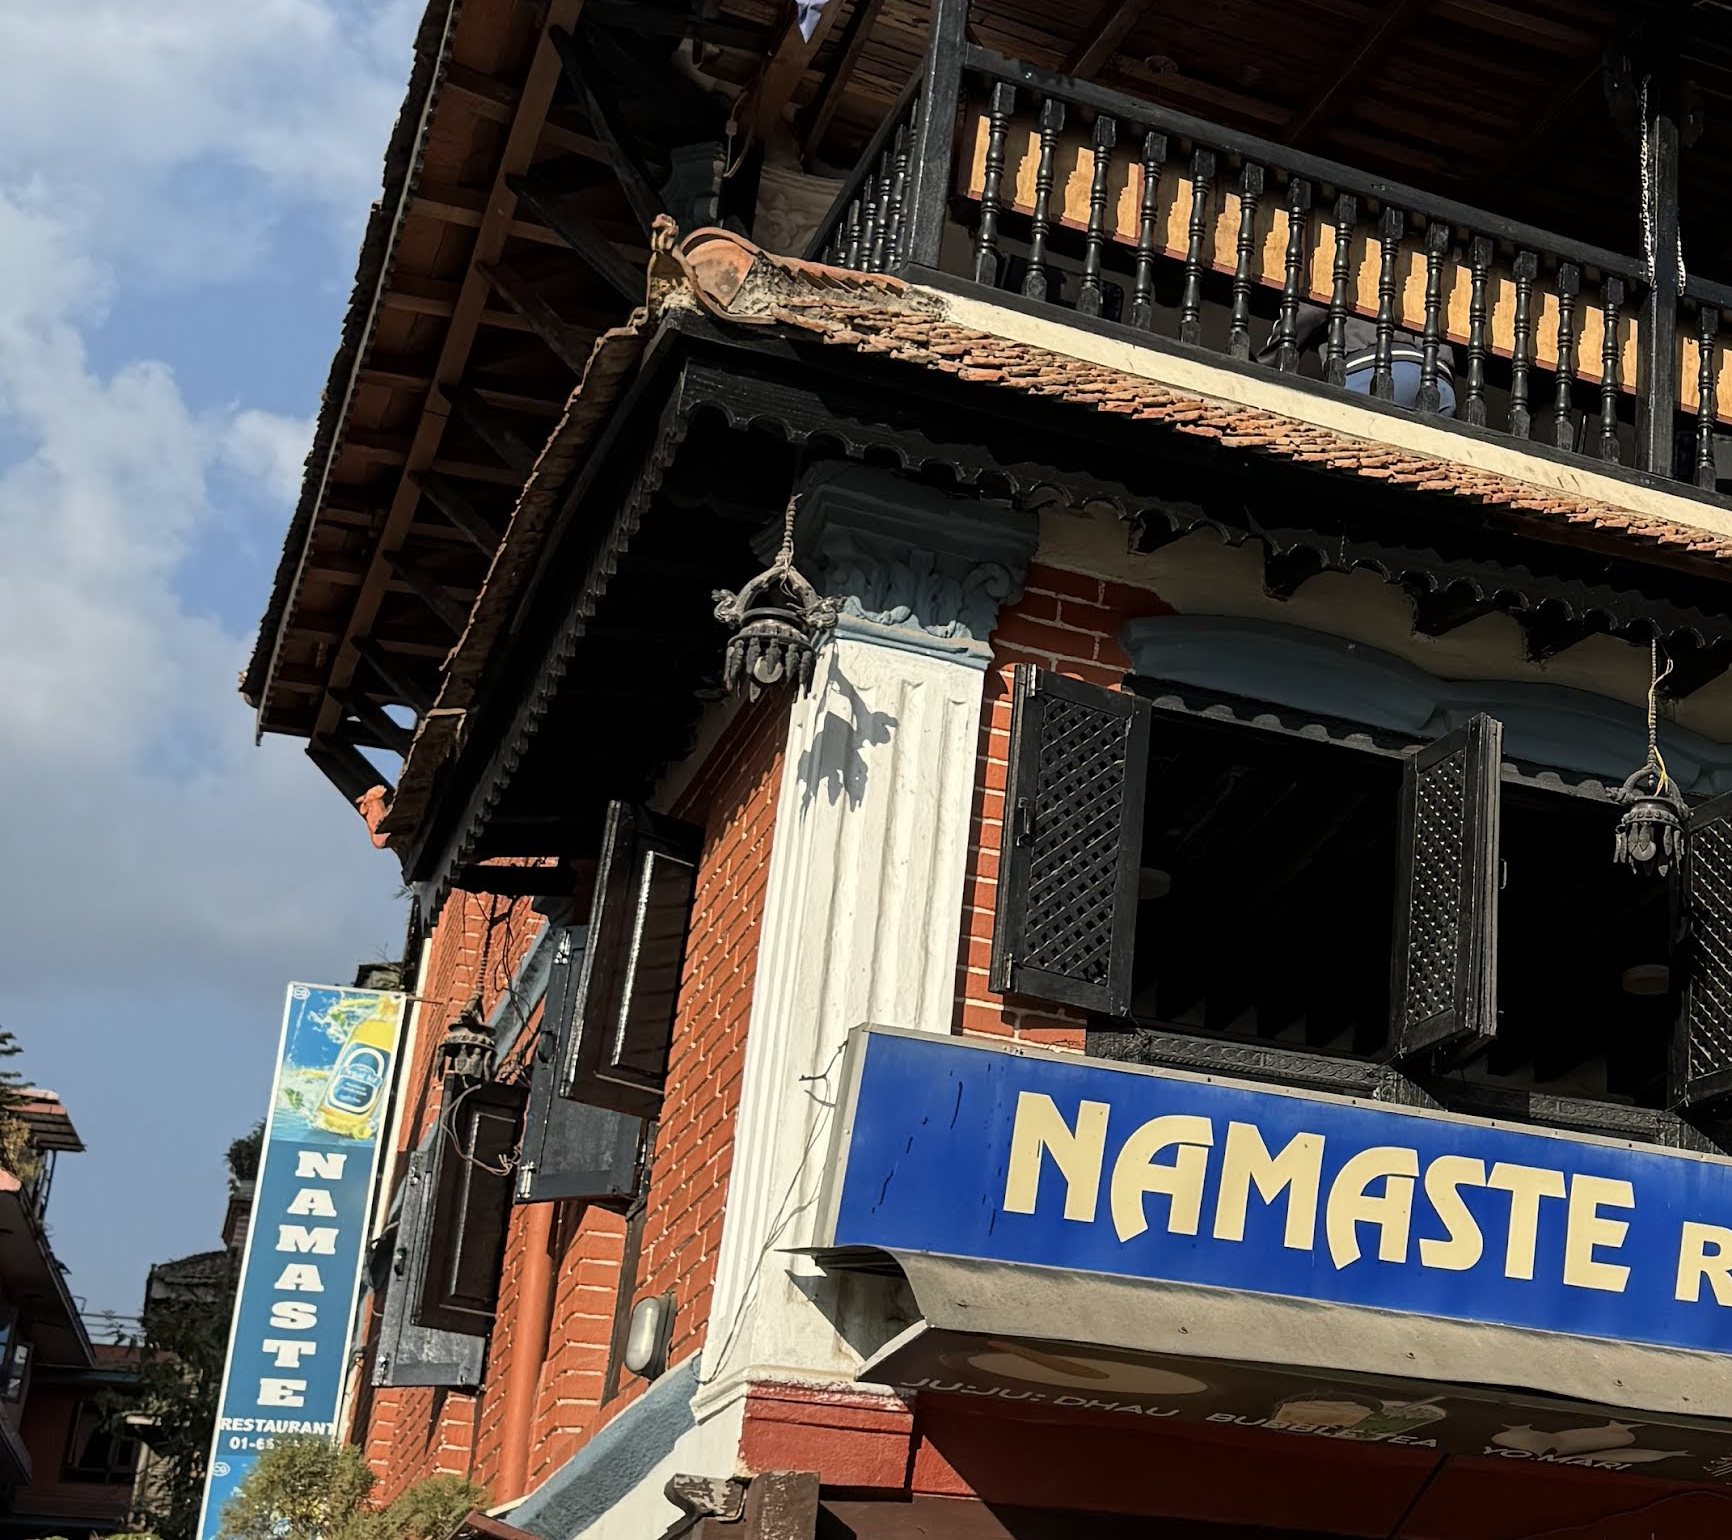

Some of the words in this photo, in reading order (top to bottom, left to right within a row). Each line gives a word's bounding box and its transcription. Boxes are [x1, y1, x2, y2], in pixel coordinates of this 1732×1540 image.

[1003, 1090, 1635, 1292] NAMASTE
[256, 1151, 348, 1409] NAMASTE
[220, 1418, 337, 1435] RESTAURANT
[1052, 1393, 1179, 1417] DHAU
[1205, 1412, 1360, 1438] BUBBLE
[1376, 1431, 1438, 1447] TEA
